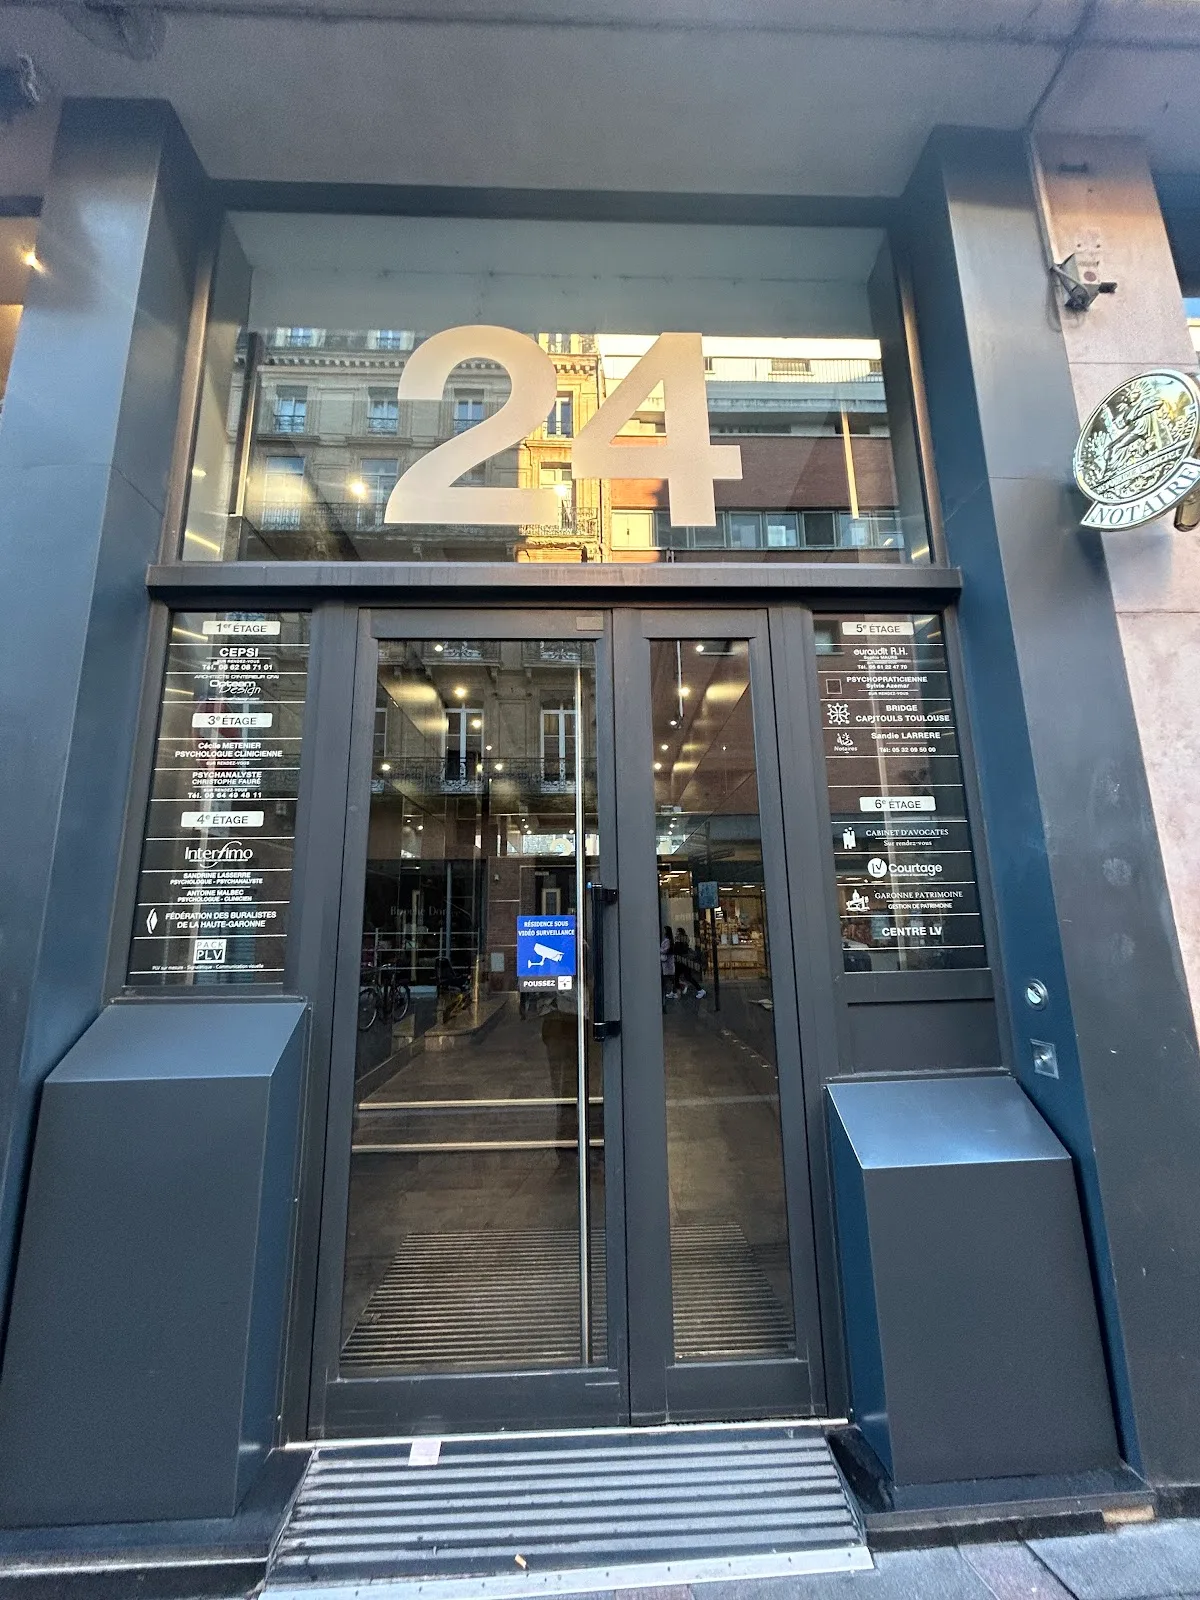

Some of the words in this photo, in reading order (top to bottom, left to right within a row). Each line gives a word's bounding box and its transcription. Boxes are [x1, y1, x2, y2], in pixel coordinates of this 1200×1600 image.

[384, 324, 744, 528] 24
[1091, 467, 1199, 523] NOTAIRE
[233, 624, 268, 633] ÉTAGE
[869, 624, 901, 633] ÉTAGE
[219, 647, 259, 657] CEPSI
[890, 647, 909, 656] R.H.
[218, 685, 262, 696] Design
[885, 704, 918, 712] BRIDGE
[222, 716, 257, 726] ÉTAGE
[905, 714, 950, 722] TOULOUSE
[871, 732, 900, 740] Sandie
[198, 742, 221, 750] Cécile
[174, 750, 233, 758] PSYCHOLOGUE
[233, 750, 283, 758] CLINICIENNE
[192, 771, 262, 779] PSYCHANALYSTE
[889, 798, 922, 809] ÉTAGE
[212, 813, 249, 825] ÉTAGE
[865, 829, 899, 837] CABINET
[901, 828, 949, 837] D'AVOCATES
[888, 863, 943, 876] Courtage
[875, 892, 914, 900] GARONNE
[915, 891, 963, 899] PATRIMOINE
[165, 911, 213, 920] FÉDÉRATION
[214, 911, 230, 919] DES
[231, 911, 277, 919] BURALISTES
[177, 921, 189, 929] DE
[200, 920, 266, 928] HAUTE-GARONNE
[523, 919, 554, 928] RÉSIDENCE
[518, 929, 536, 937] VIDÉO
[882, 927, 927, 937] CENTRE
[929, 927, 942, 935] LV
[196, 941, 224, 949] PACK
[196, 950, 223, 960] PLV
